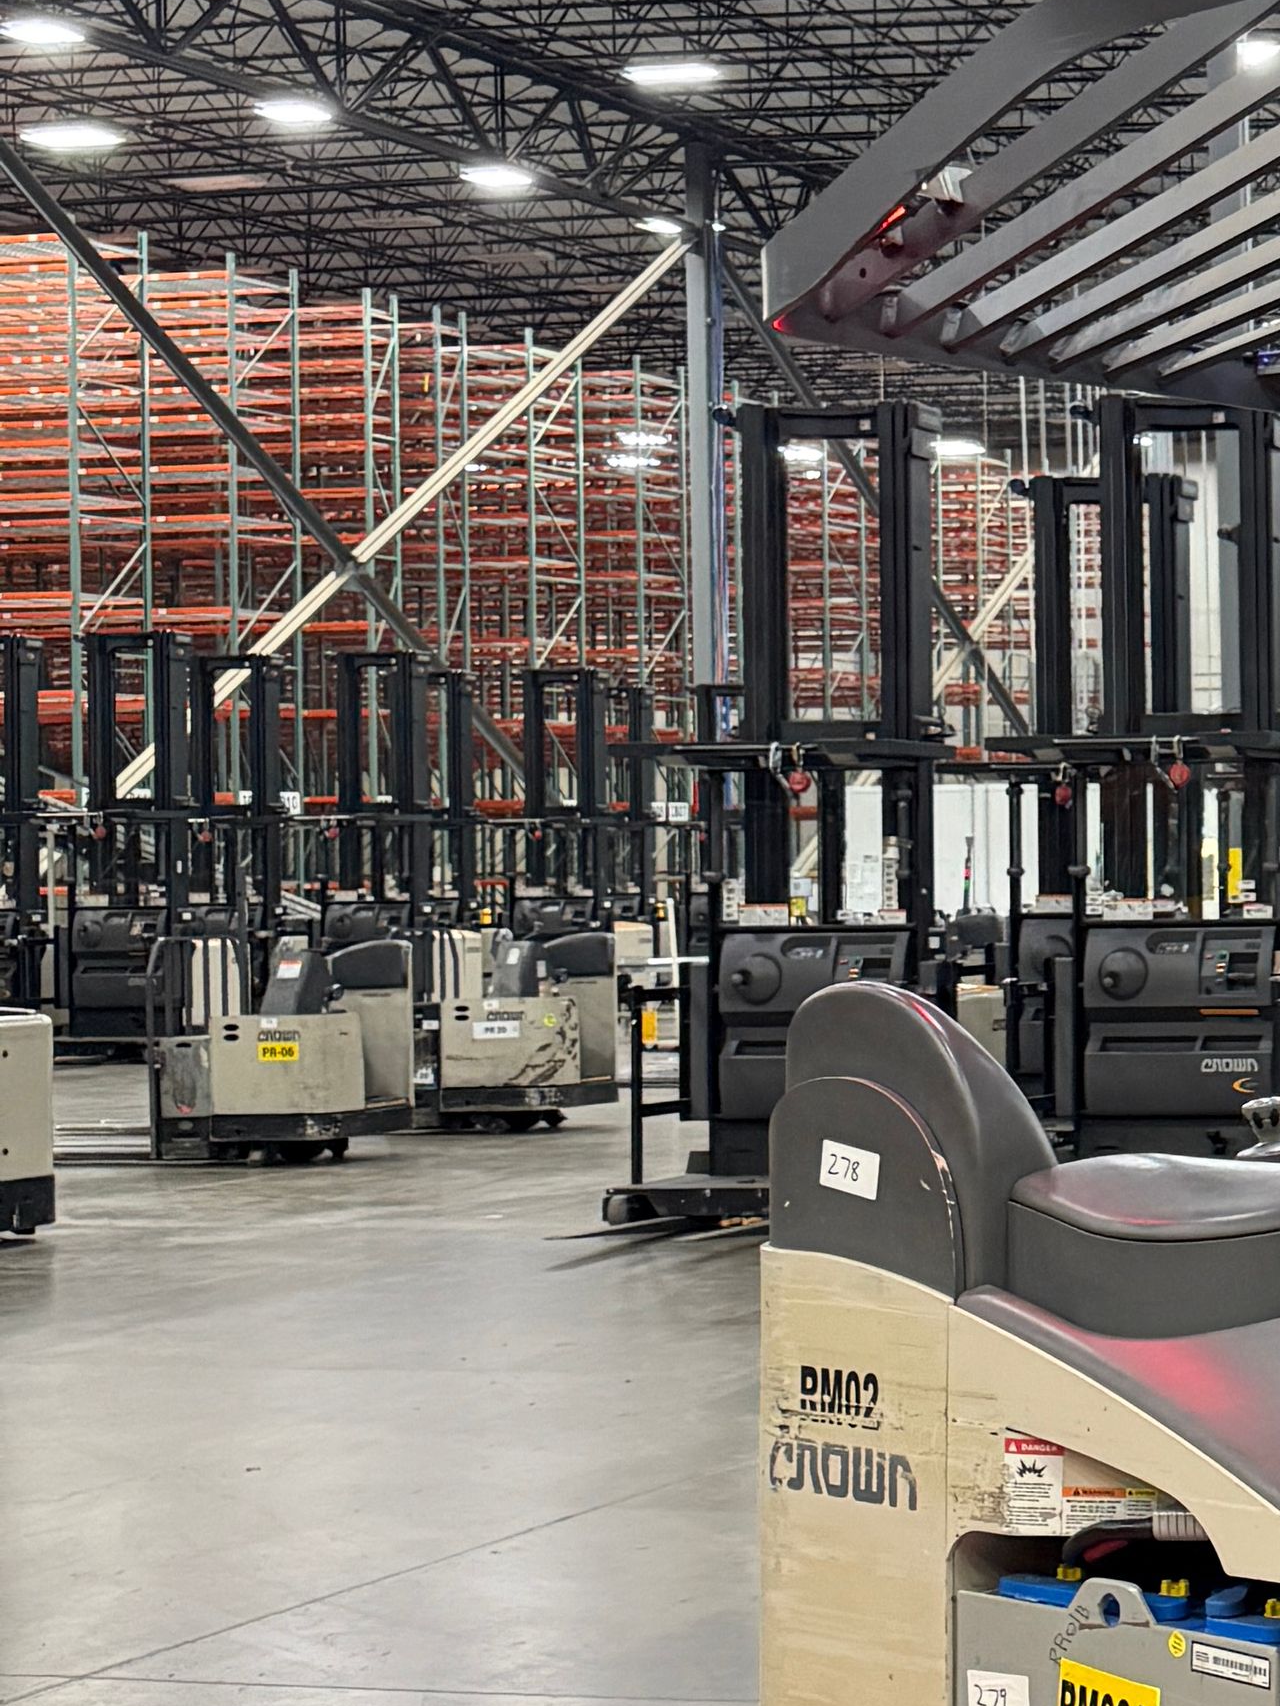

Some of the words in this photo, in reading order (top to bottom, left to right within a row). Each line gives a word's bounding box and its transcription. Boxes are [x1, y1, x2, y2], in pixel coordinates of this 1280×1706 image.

[1200, 1058, 1259, 1072] CROWN
[827, 1153, 860, 1182] 278
[800, 1364, 881, 1431] RM02
[769, 1438, 918, 1511] CROWN
